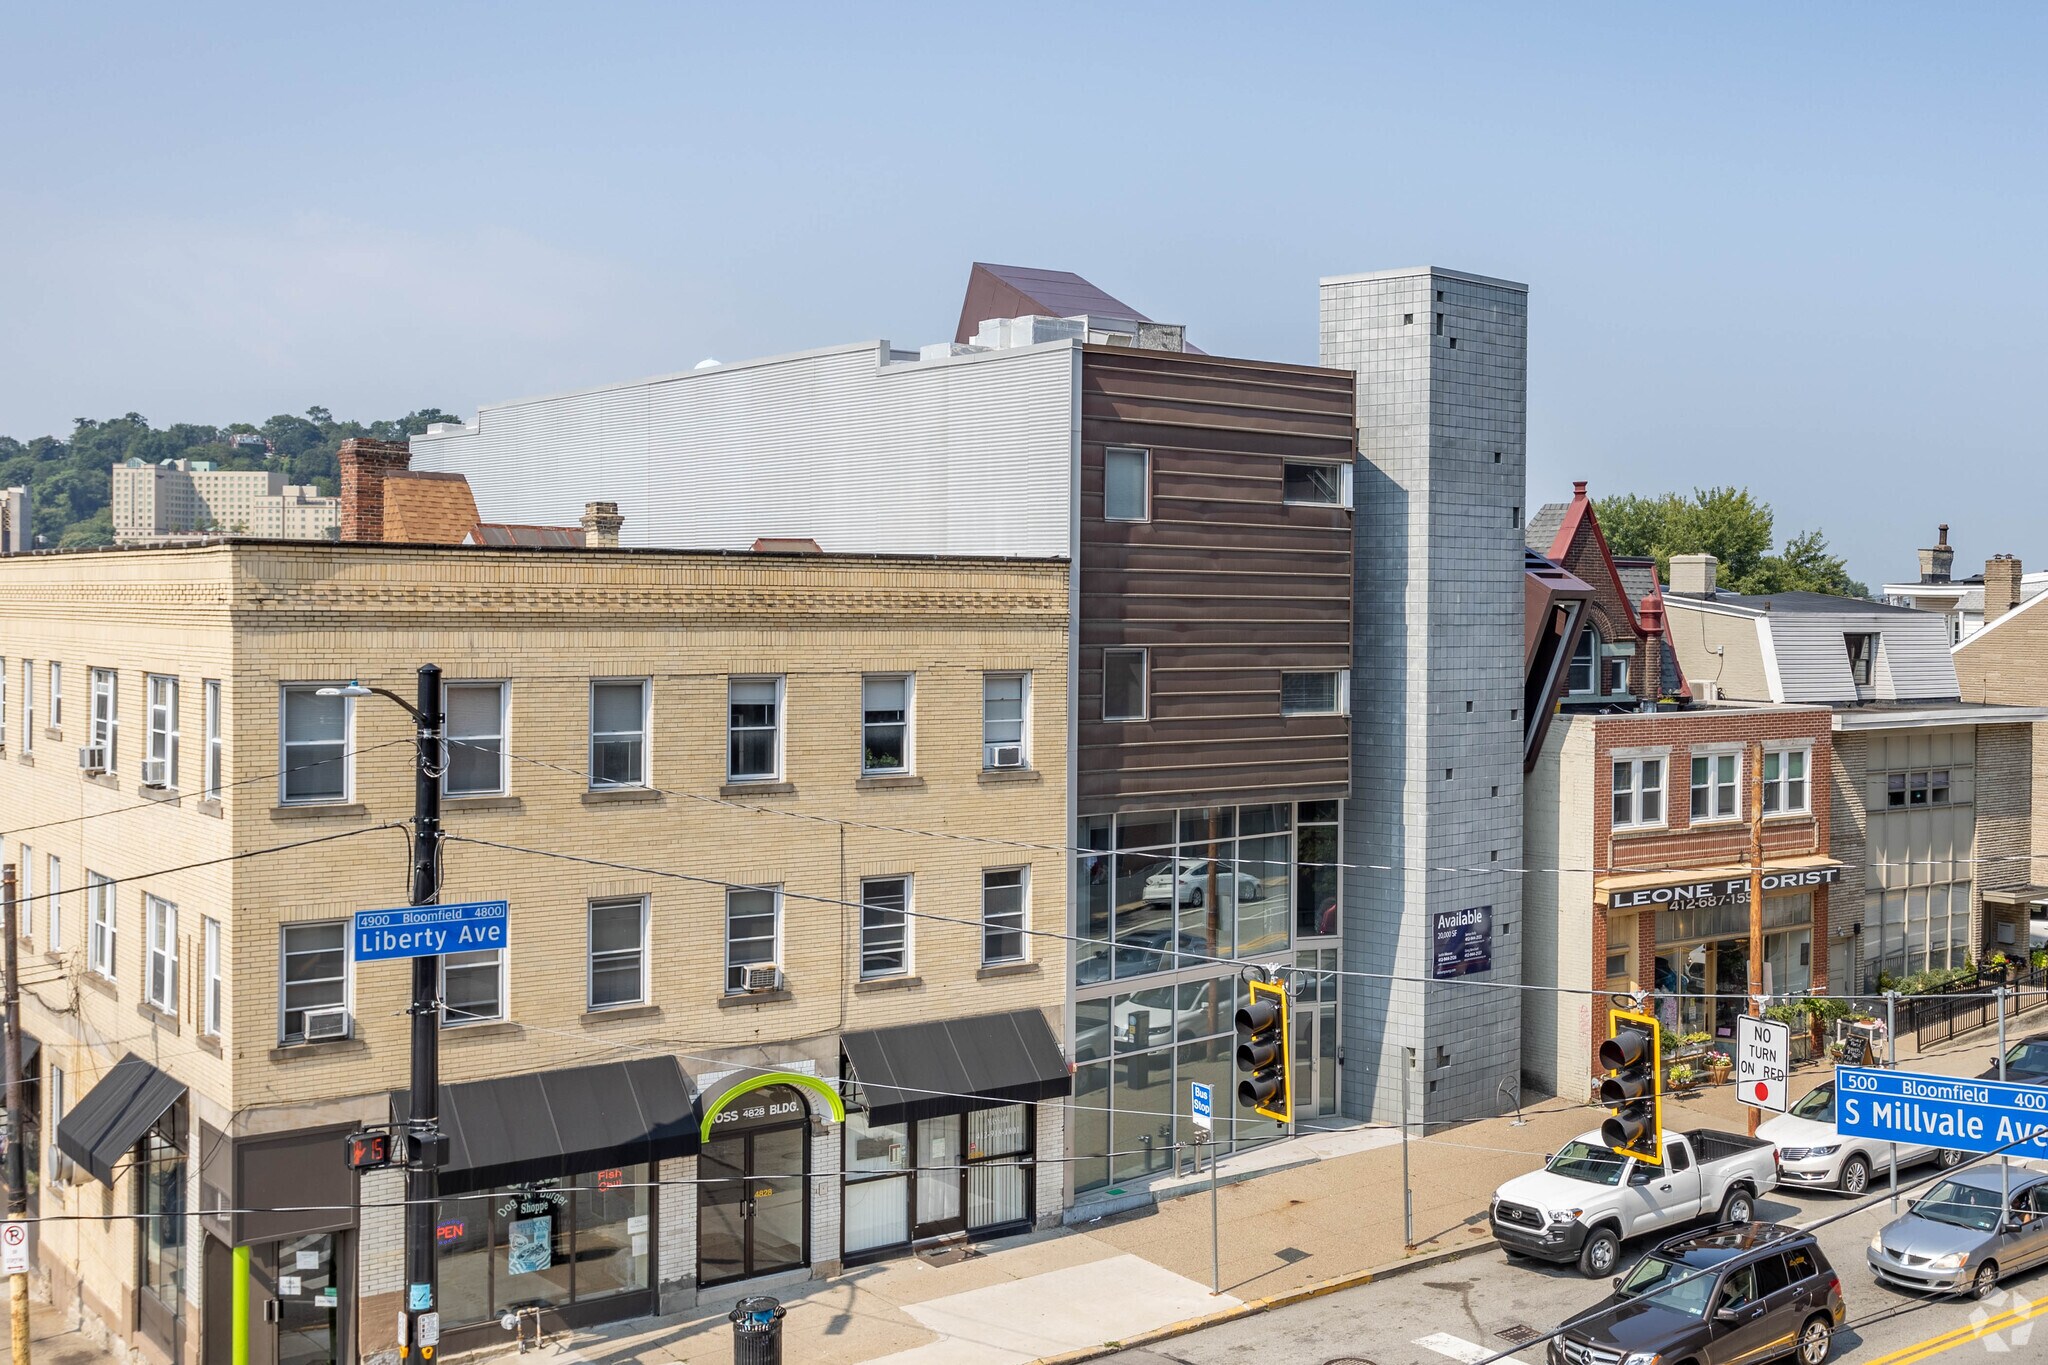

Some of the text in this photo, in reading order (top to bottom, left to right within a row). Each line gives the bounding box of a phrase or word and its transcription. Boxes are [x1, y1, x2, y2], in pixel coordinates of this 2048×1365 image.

[1614, 869, 1838, 908] LEONE FLORIST
[1669, 890, 1763, 911] 412-687-159
[360, 906, 502, 927] 4900 Bloomfield 4800
[1437, 909, 1483, 929] Available
[362, 925, 501, 952] Liberty Ave
[1754, 1026, 1771, 1043] NO
[1749, 1044, 1777, 1063] TURN
[1740, 1060, 1784, 1082] ON RED
[1194, 1086, 1208, 1100] Bus
[1848, 1075, 2047, 1110] 500 Bloomfield 400
[712, 1101, 799, 1124] OSS 4828 BLDG.
[1194, 1099, 1210, 1114] Stop
[1845, 1098, 2048, 1148] S Millvale Ave
[371, 1138, 383, 1160] 15
[598, 1169, 622, 1181] Fish
[754, 1188, 773, 1198] 4828
[497, 1199, 518, 1217] Dog
[520, 1200, 549, 1215] Shoppe
[437, 1224, 463, 1240] PEN
